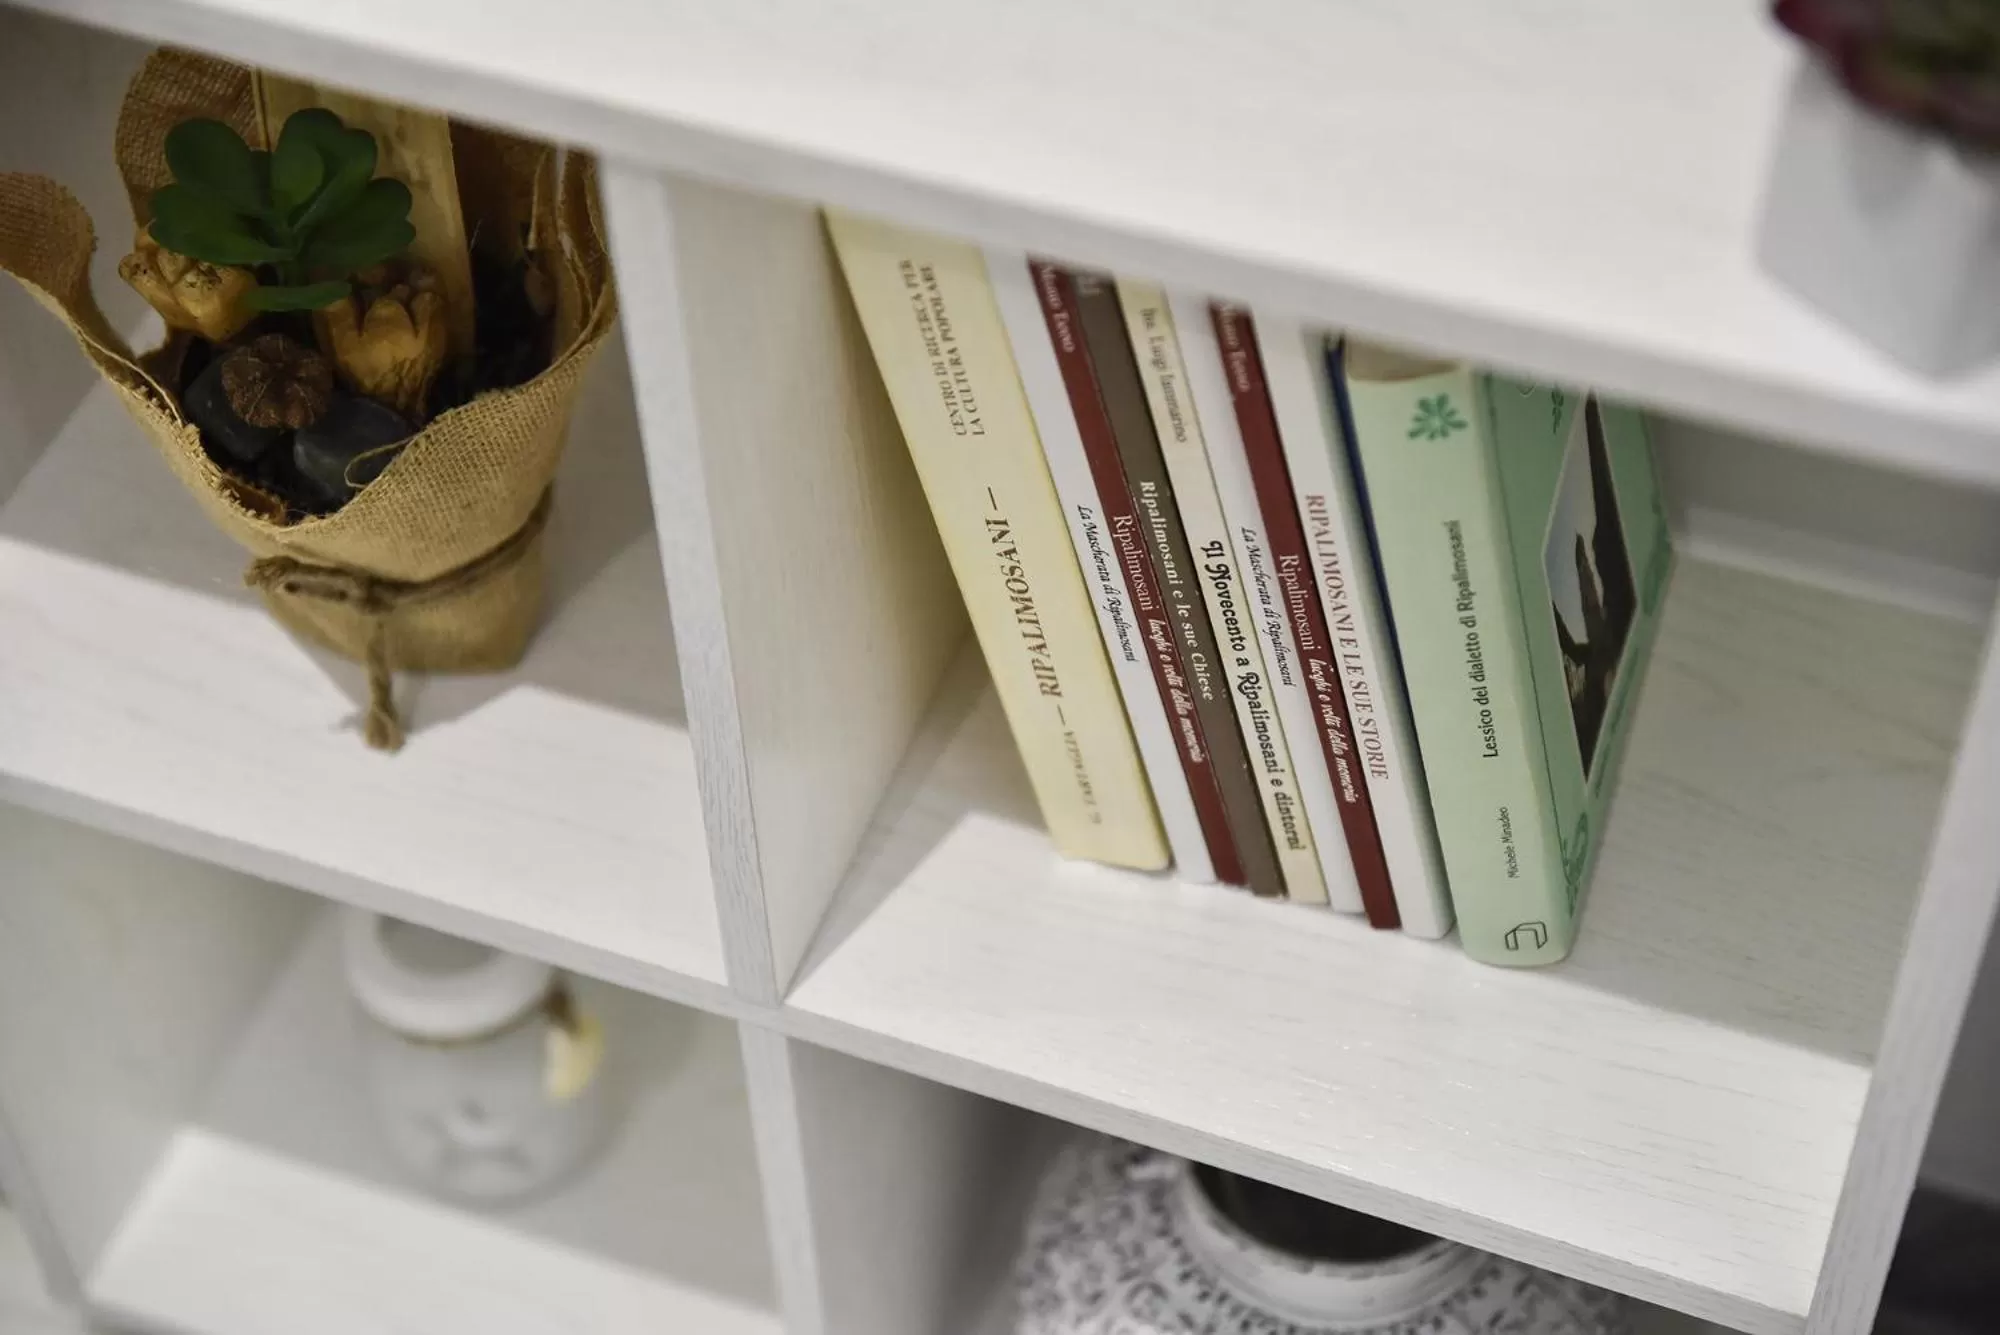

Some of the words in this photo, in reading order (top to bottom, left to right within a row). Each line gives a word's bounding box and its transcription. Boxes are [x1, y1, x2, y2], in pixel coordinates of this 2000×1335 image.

[932, 362, 948, 376] DI
[948, 347, 977, 413] CULTURA
[940, 381, 967, 436] CENTRO
[970, 418, 984, 435] LA
[1077, 505, 1092, 520] La
[1140, 482, 1183, 584] Ripalimosani
[1242, 528, 1256, 542] La
[1083, 522, 1110, 581] Mascherata
[1110, 515, 1159, 610] Ripalimosani
[1201, 541, 1224, 558] Il
[1306, 496, 1354, 632] RIPALIMOSANI
[1444, 520, 1475, 612] Ripalimosani
[1103, 584, 1120, 594] di
[1173, 590, 1183, 598] e
[1246, 546, 1271, 604] Mascherata
[985, 518, 1062, 697] RIPALIMOSANI
[1176, 604, 1191, 617] le
[1204, 564, 1246, 651] Novecento
[1264, 606, 1280, 618] di
[1273, 555, 1321, 651] Ripalimosani
[1459, 616, 1476, 628] di
[1103, 597, 1138, 661] Ripalimosani
[1182, 623, 1197, 647] sue
[1263, 618, 1296, 686] Ripalimosani
[1340, 638, 1357, 647] E
[1192, 653, 1213, 700] Chiese
[1236, 658, 1249, 666] a
[1344, 654, 1364, 674] LE
[1466, 632, 1485, 682] dialetto
[1350, 681, 1373, 712] SUE
[1472, 686, 1489, 705] del
[1233, 672, 1284, 773] Ripalimosani
[1478, 710, 1498, 758] Lessico
[1357, 718, 1388, 779] STORIE
[1274, 792, 1306, 850] dintorni
[1498, 807, 1512, 843] Minadeo
[1504, 846, 1520, 878] Michele
